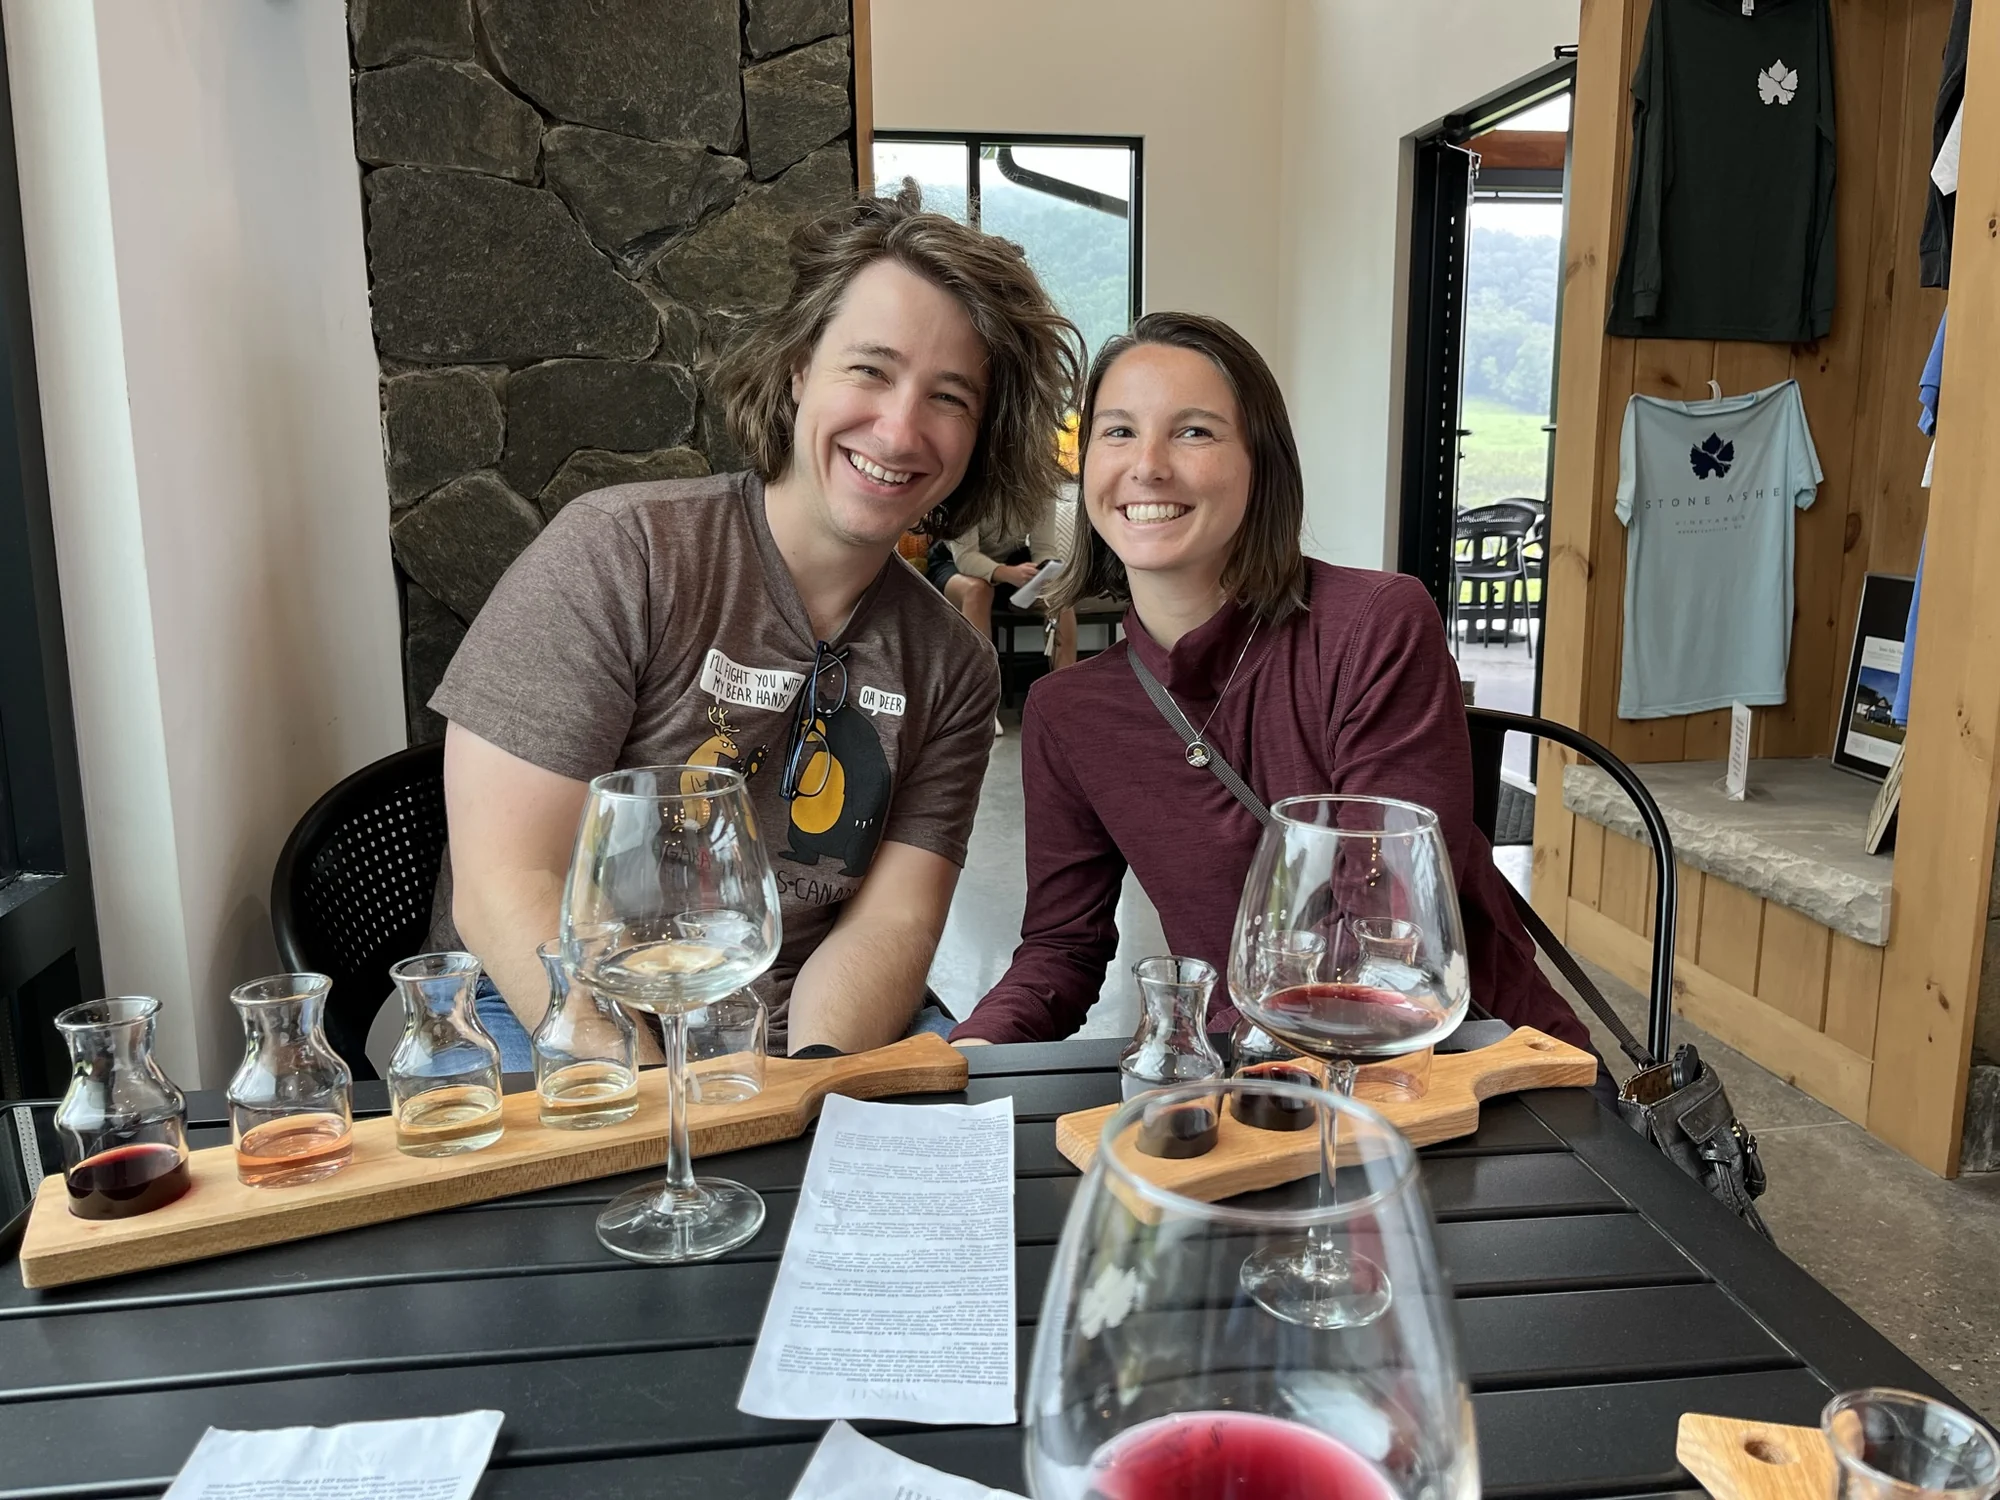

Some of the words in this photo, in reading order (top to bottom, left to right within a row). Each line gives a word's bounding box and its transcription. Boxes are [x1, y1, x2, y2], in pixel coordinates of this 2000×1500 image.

[1644, 495, 1711, 510] STONE
[1726, 487, 1780, 504] ASHE
[712, 674, 725, 695] MY
[725, 682, 752, 703] BEAR
[724, 662, 751, 685] FIGHT
[754, 673, 777, 688] YOU
[782, 675, 803, 693] WITH
[862, 690, 875, 706] OH
[879, 693, 903, 713] DEER
